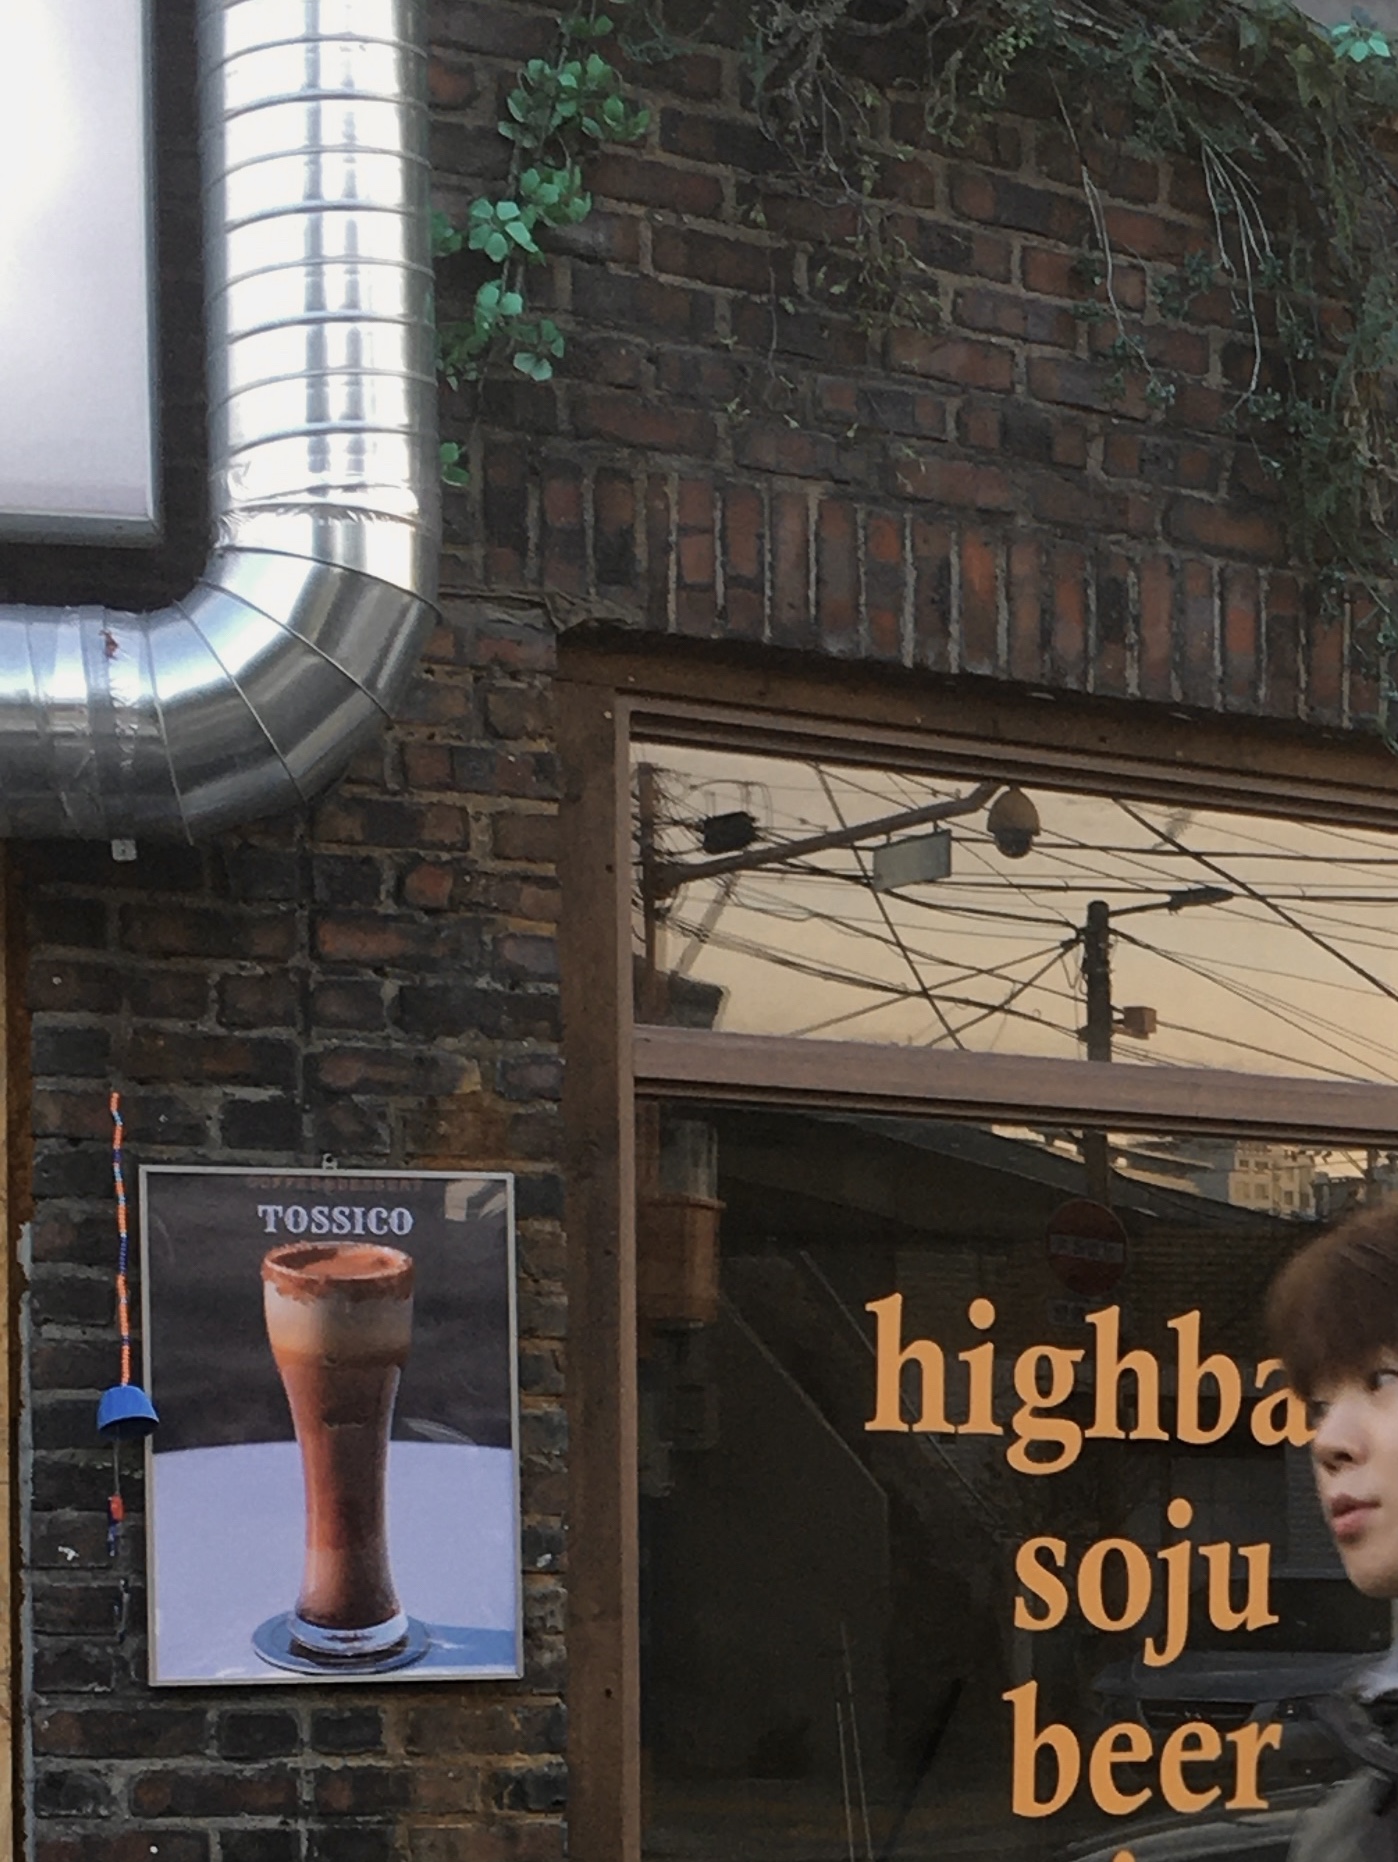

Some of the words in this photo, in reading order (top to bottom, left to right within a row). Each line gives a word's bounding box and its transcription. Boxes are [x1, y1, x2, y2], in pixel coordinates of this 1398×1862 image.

[256, 1204, 414, 1236] TOSSICO
[864, 1291, 1319, 1476] highba
[1012, 1497, 1279, 1667] soju
[1001, 1679, 1283, 1818] beer
